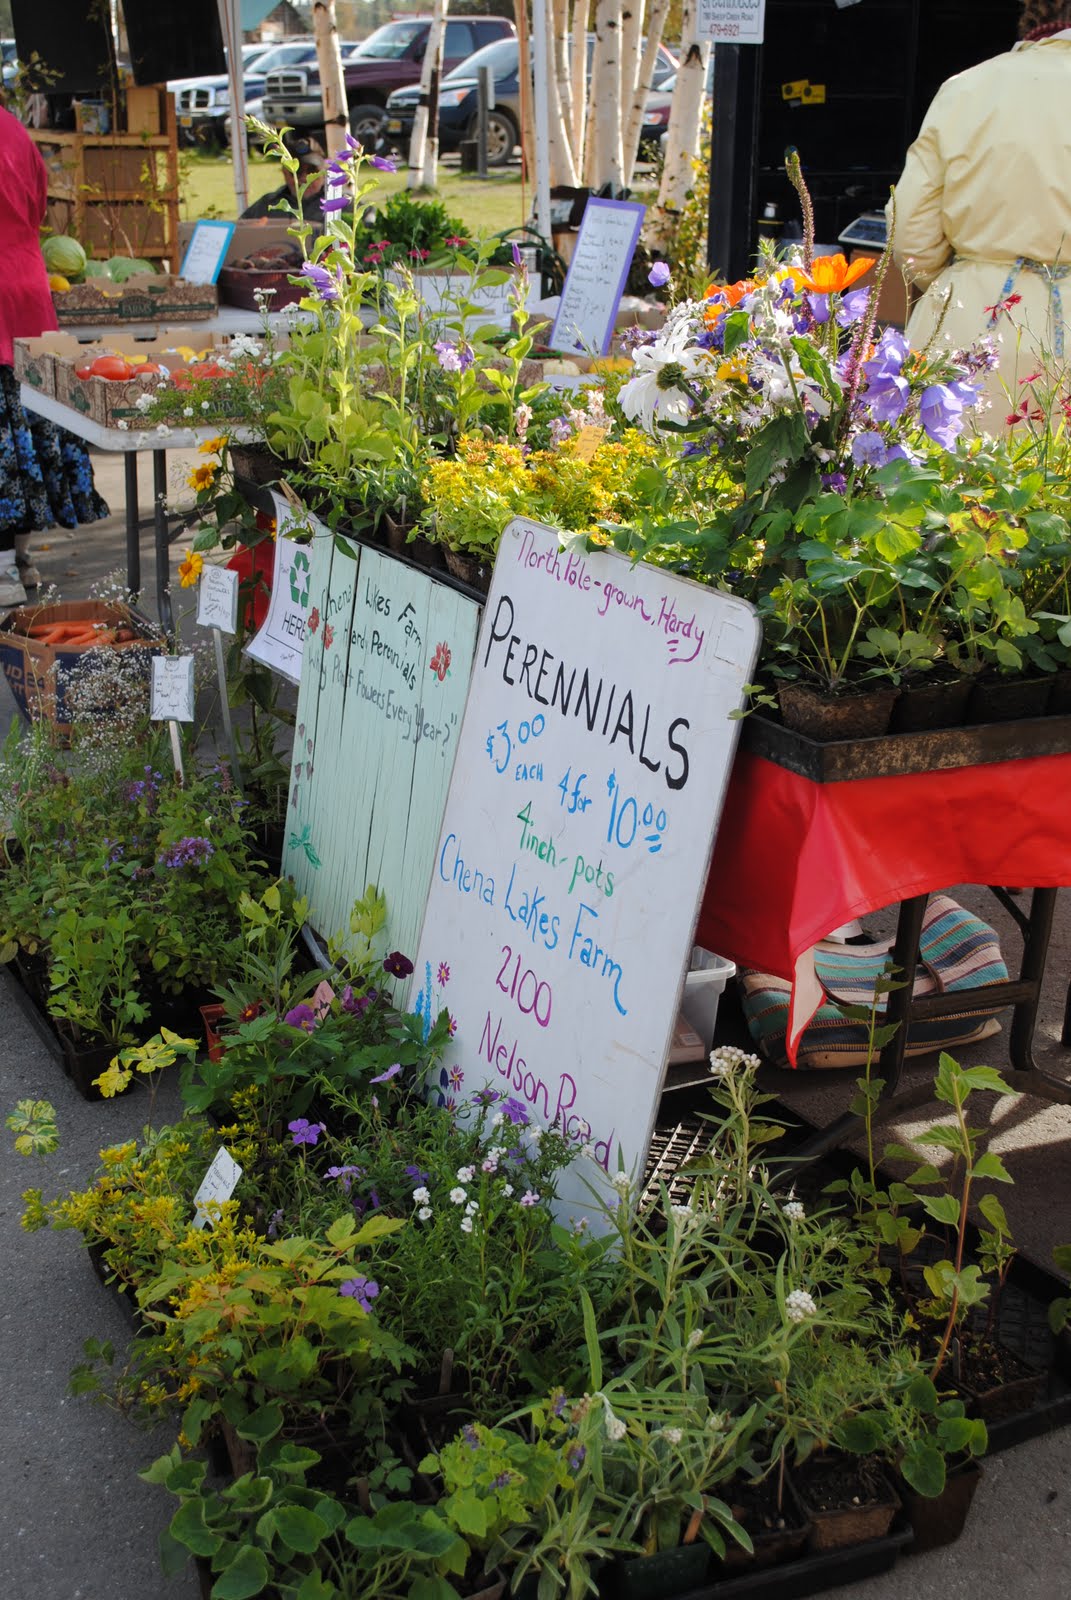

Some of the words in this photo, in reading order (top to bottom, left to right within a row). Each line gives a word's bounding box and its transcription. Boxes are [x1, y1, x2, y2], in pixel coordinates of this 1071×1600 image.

[121, 303, 152, 315] FARMS
[282, 611, 306, 642] HERE
[657, 595, 705, 665] Hardy
[332, 654, 354, 689] Plat
[484, 595, 690, 790] PERENNIALS
[486, 713, 546, 774] $3.00
[515, 763, 544, 782] EACH
[606, 768, 667, 850] $10.00
[440, 833, 495, 905] Chena
[504, 863, 560, 950] Lakes
[569, 902, 627, 1016] Farm
[496, 945, 552, 1028] 2100
[478, 1010, 550, 1120] Nelson
[556, 1072, 616, 1173] Road
